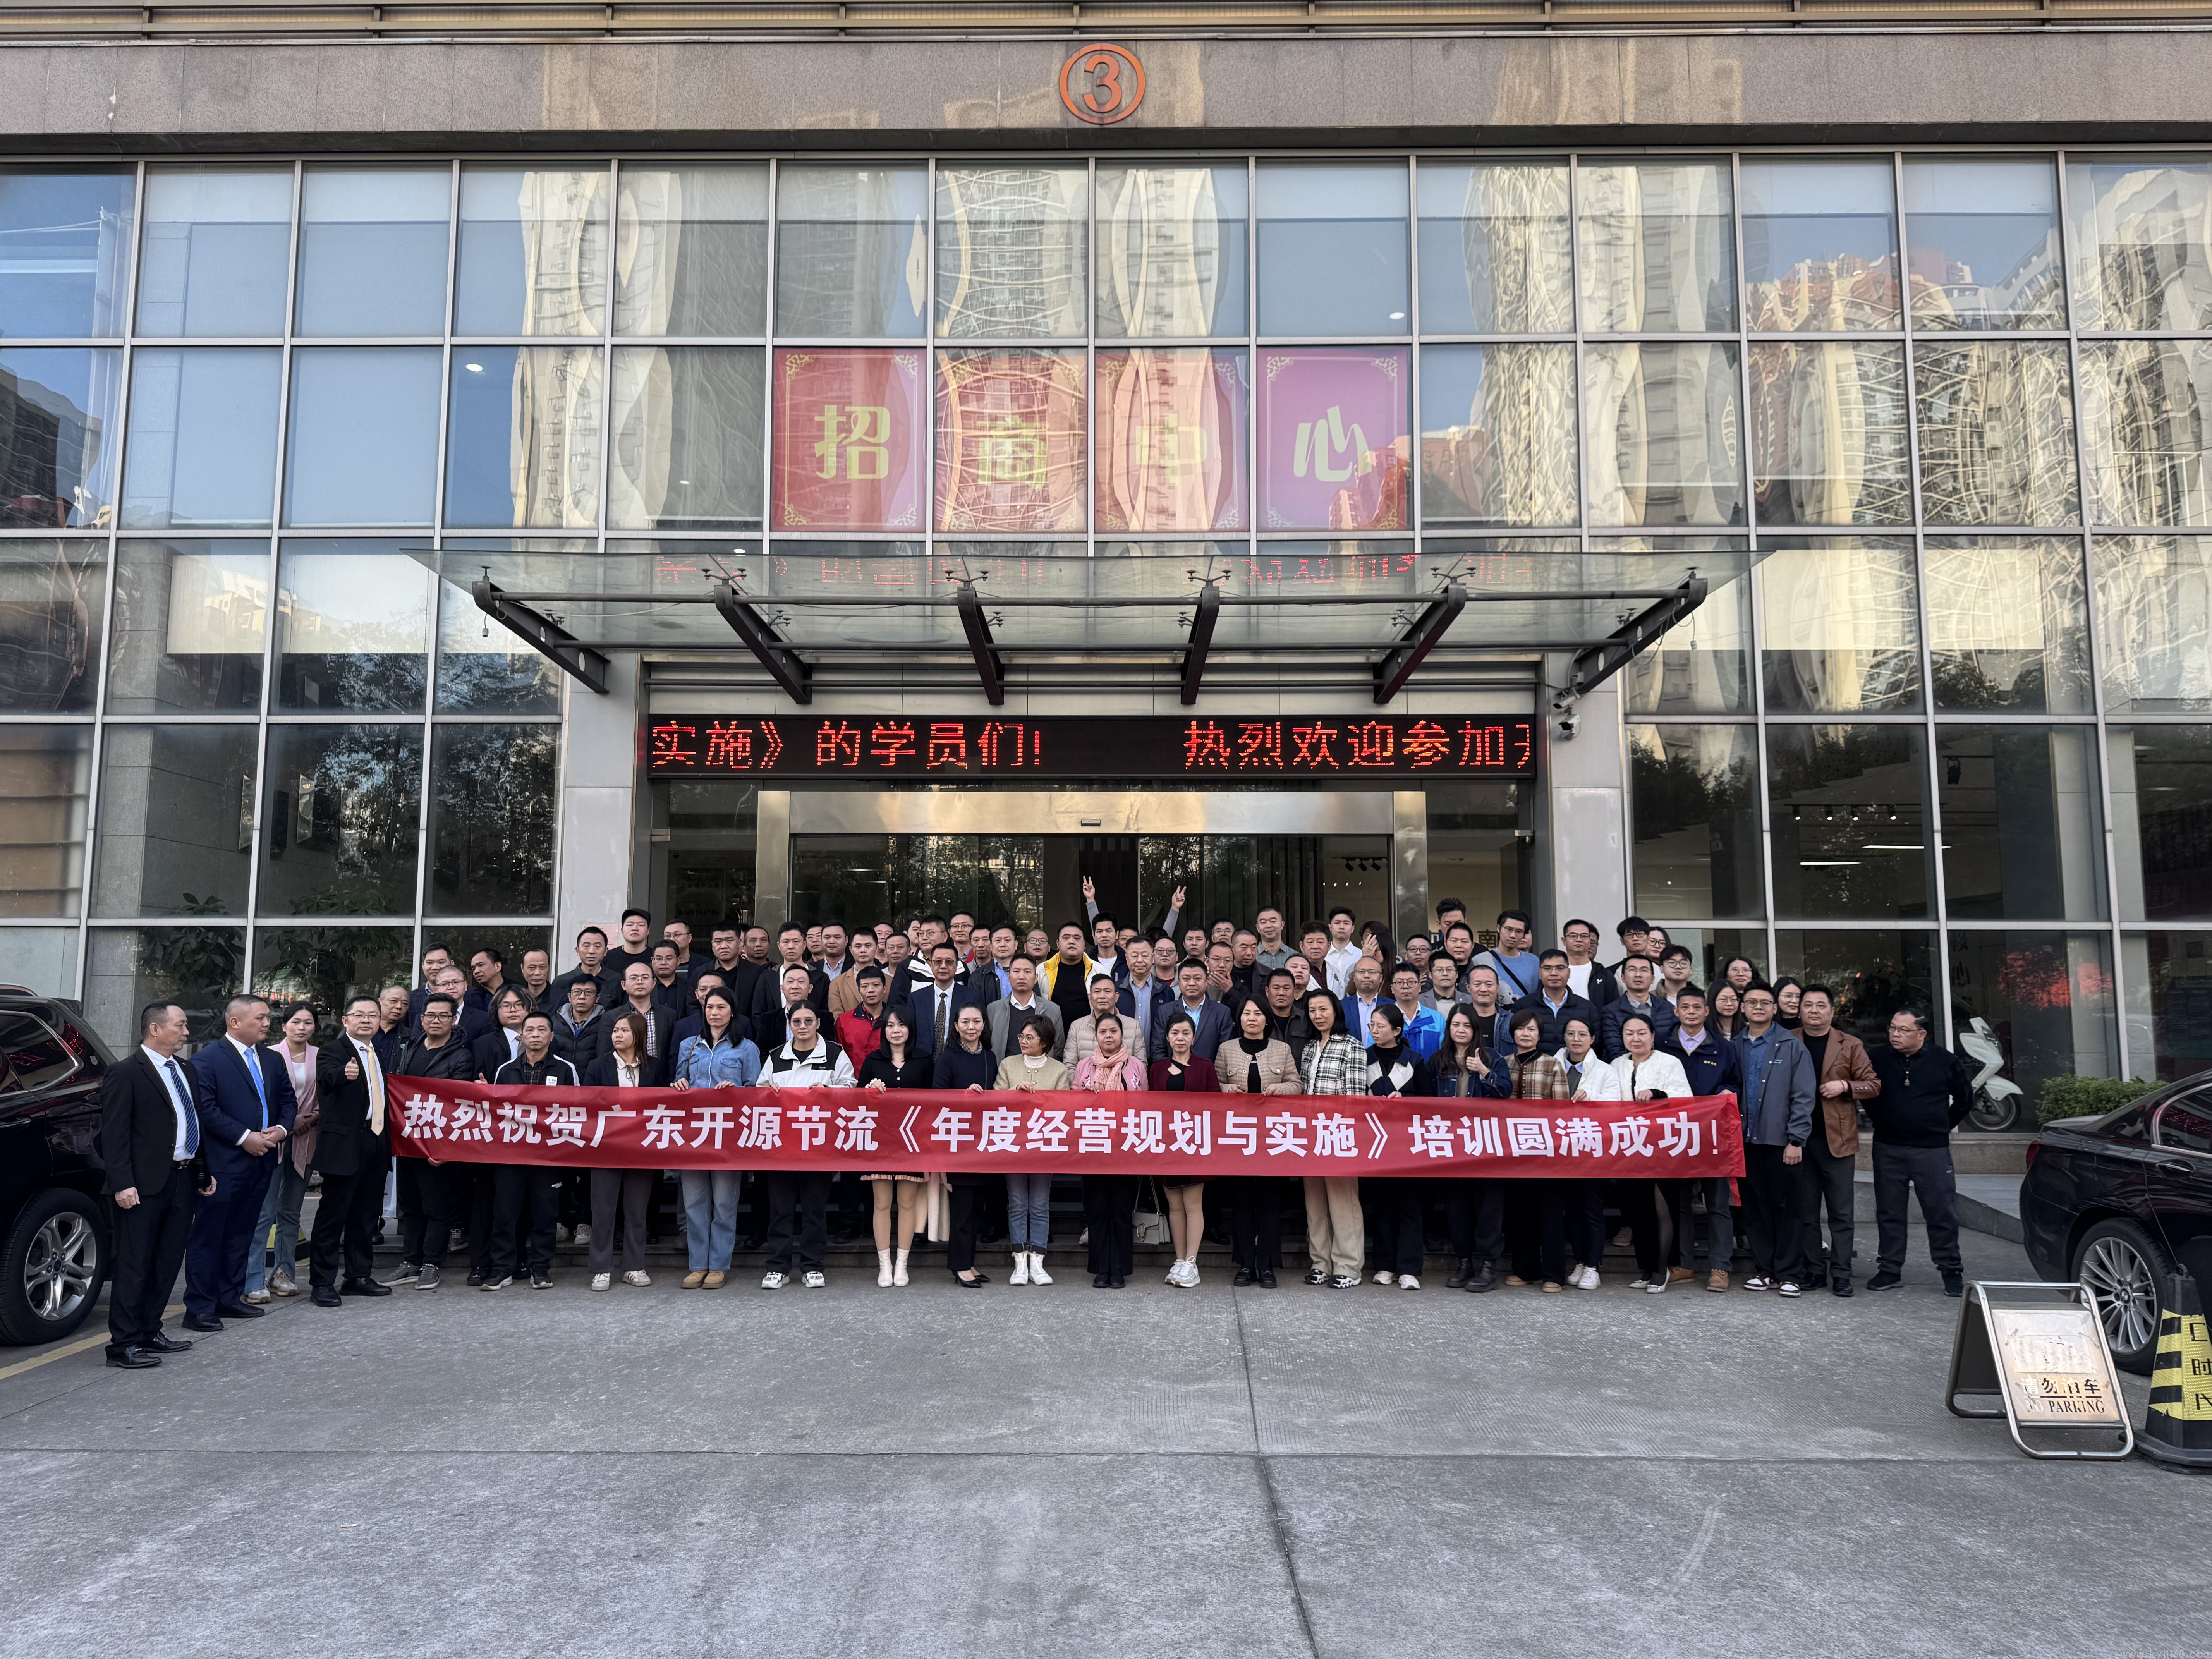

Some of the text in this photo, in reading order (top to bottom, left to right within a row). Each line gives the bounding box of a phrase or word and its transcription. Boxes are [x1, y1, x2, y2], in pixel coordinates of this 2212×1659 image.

[814, 404, 1372, 490] 招商中心
[401, 1093, 1718, 1159] 热烈祝贺广东开源节流《年度经营规划与实施》培训圆满成功！
[2048, 1400, 2105, 1413] PARKING
